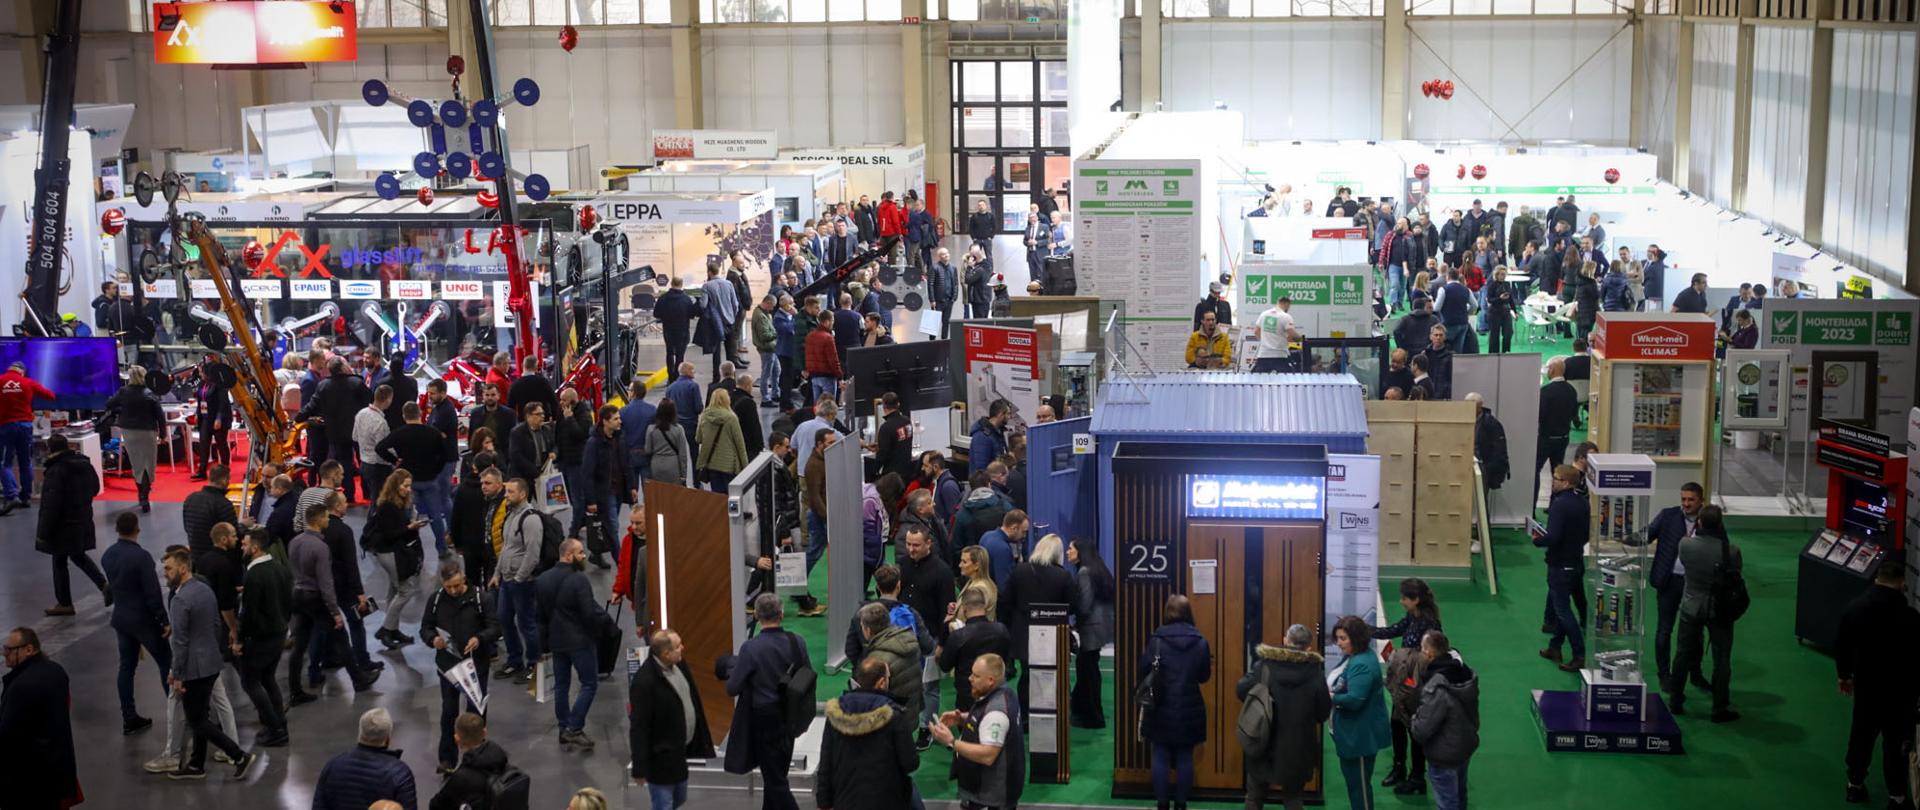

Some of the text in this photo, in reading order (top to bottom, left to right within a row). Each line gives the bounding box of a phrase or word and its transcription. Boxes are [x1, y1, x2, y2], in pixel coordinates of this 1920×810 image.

[871, 156, 893, 165] SRL
[614, 203, 662, 220] EPPA
[40, 191, 60, 269] 504 304 604
[341, 246, 424, 268] glasslift
[445, 283, 479, 293] UNIC
[1274, 281, 1327, 289] MONTERIADA
[1288, 290, 1317, 301] 2023
[1805, 317, 1868, 327] MONTERIADA
[1821, 328, 1856, 340] 2023
[1877, 330, 1910, 338] DOBRY
[1641, 348, 1678, 356] KLIMAS
[1075, 437, 1089, 446] 109
[1345, 516, 1369, 525] WINS
[1130, 544, 1168, 572] 25
